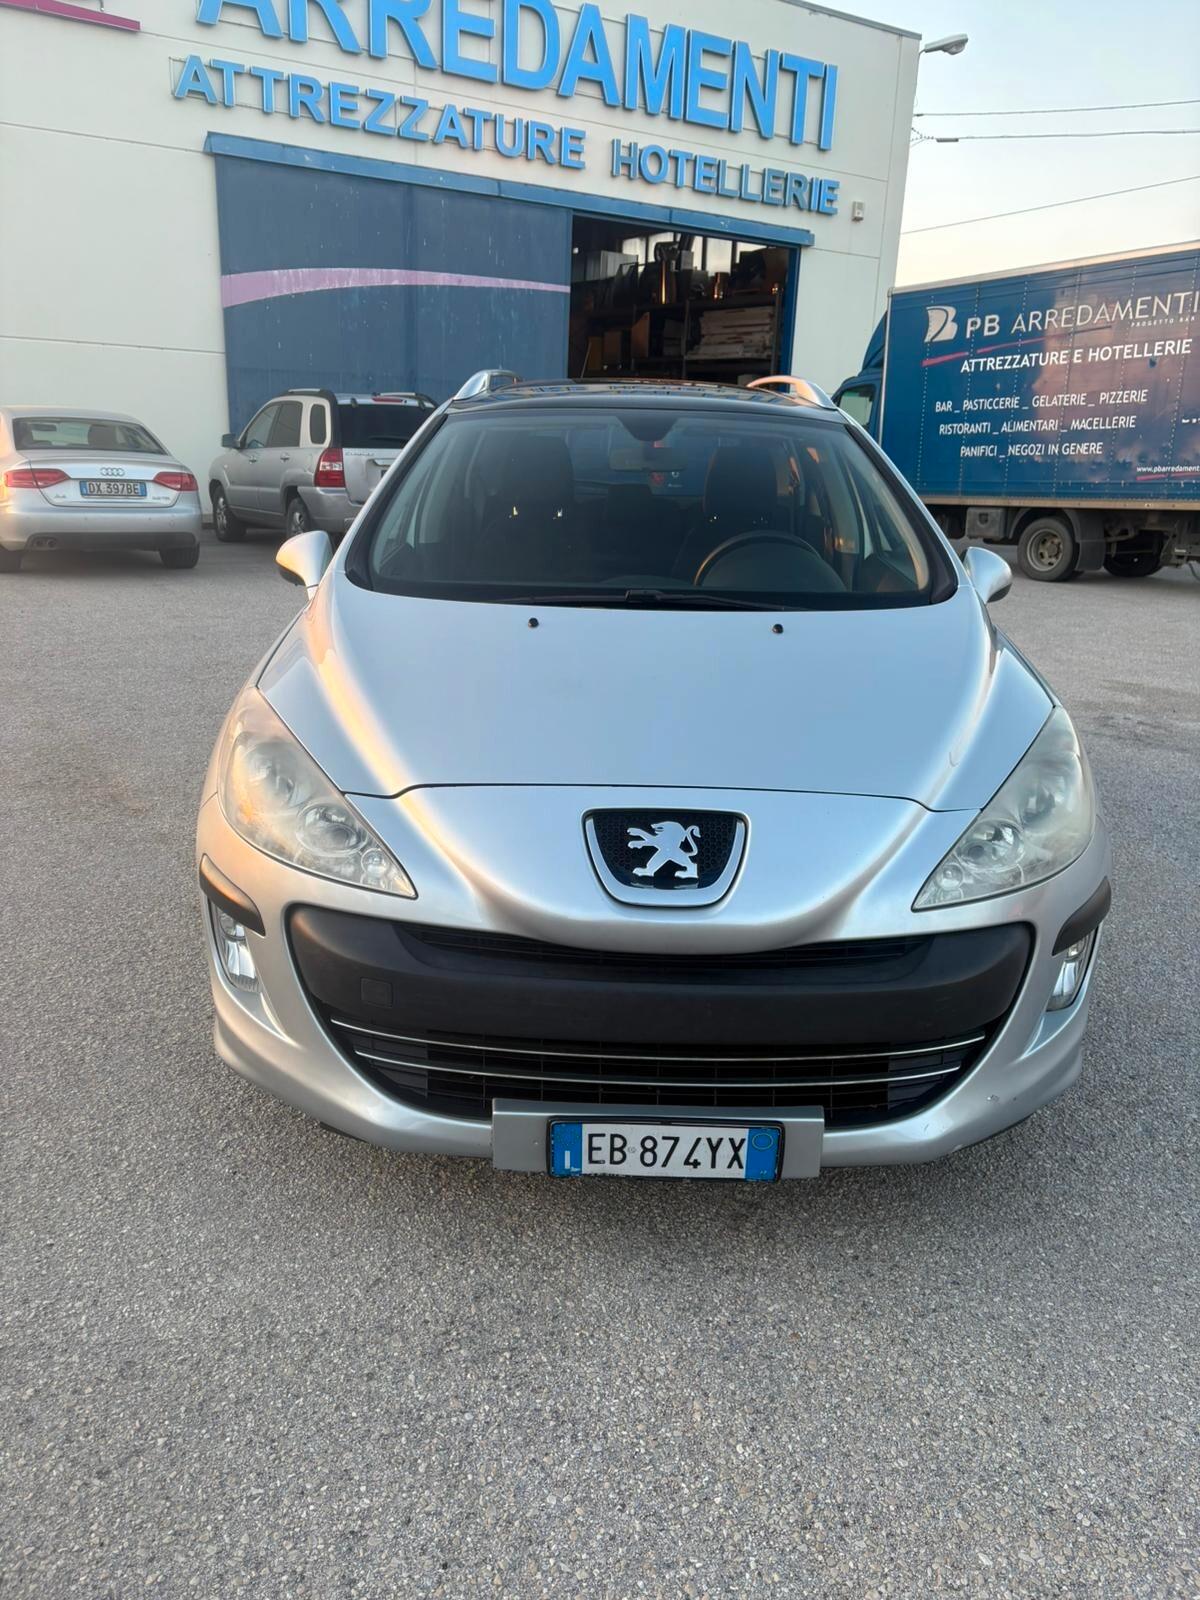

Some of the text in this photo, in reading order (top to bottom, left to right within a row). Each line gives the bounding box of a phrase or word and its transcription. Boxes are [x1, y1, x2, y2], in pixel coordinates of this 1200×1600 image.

[175, 55, 840, 215] ATTREZZATURE HOTELLERIE
[966, 291, 1200, 338] PB ARREDAMENTI
[960, 339, 1193, 373] ATTREZZATURE E HOTELLERIE
[935, 400, 953, 413] BAR
[963, 397, 1020, 411] PASTICCERIE
[1032, 393, 1087, 408] GELATERIE
[1099, 389, 1148, 405] PIZZERIE
[940, 422, 991, 435] RISTORANTI
[1001, 419, 1058, 433] ALIMENTARI
[1070, 415, 1136, 431] MACELLERIE
[960, 445, 997, 457] PANIFICI
[1008, 443, 1045, 456] NEGOZI
[1048, 443, 1059, 456] IN
[1062, 442, 1103, 456] GENERE
[1136, 464, 1200, 473] www.pbarredament
[88, 481, 102, 494] DX
[106, 482, 139, 495] 397BE
[588, 1133, 627, 1165] EB
[640, 1135, 746, 1169] 874YX
